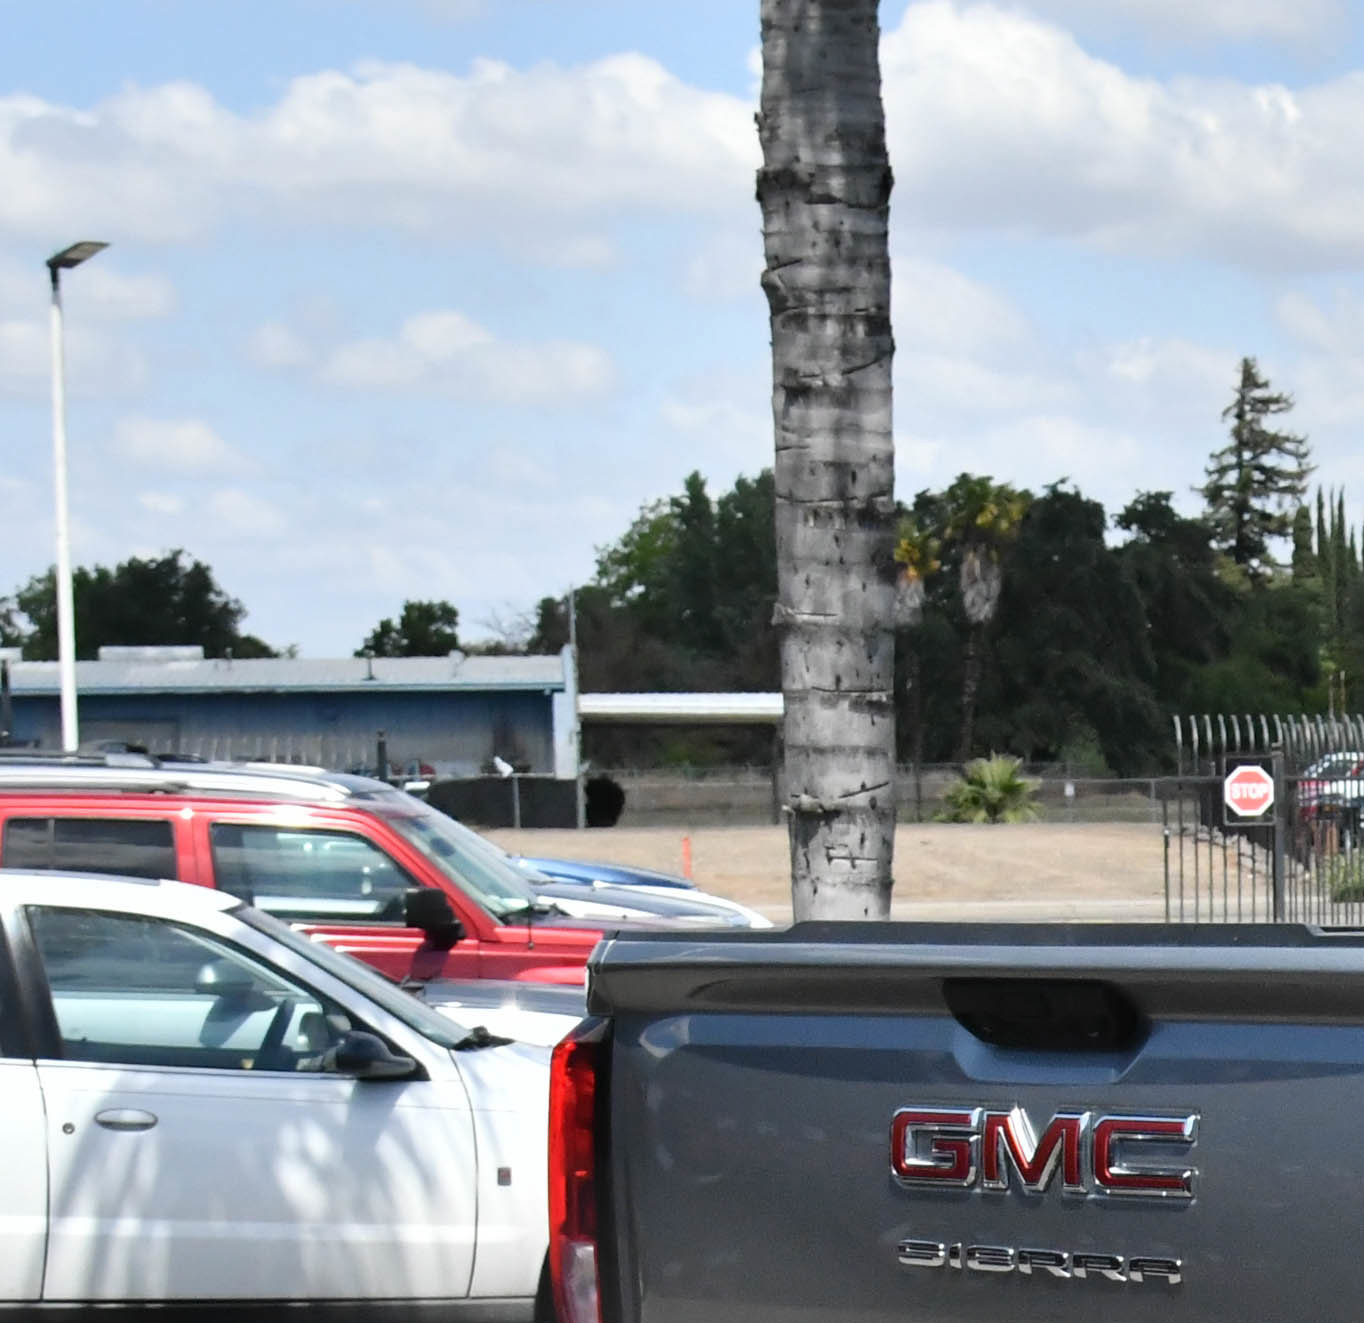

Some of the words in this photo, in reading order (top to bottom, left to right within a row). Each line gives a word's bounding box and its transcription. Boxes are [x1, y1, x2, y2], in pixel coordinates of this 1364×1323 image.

[1231, 783, 1269, 800] STOP
[891, 1105, 1200, 1205] GMC
[898, 1239, 1183, 1284] SIERRA
